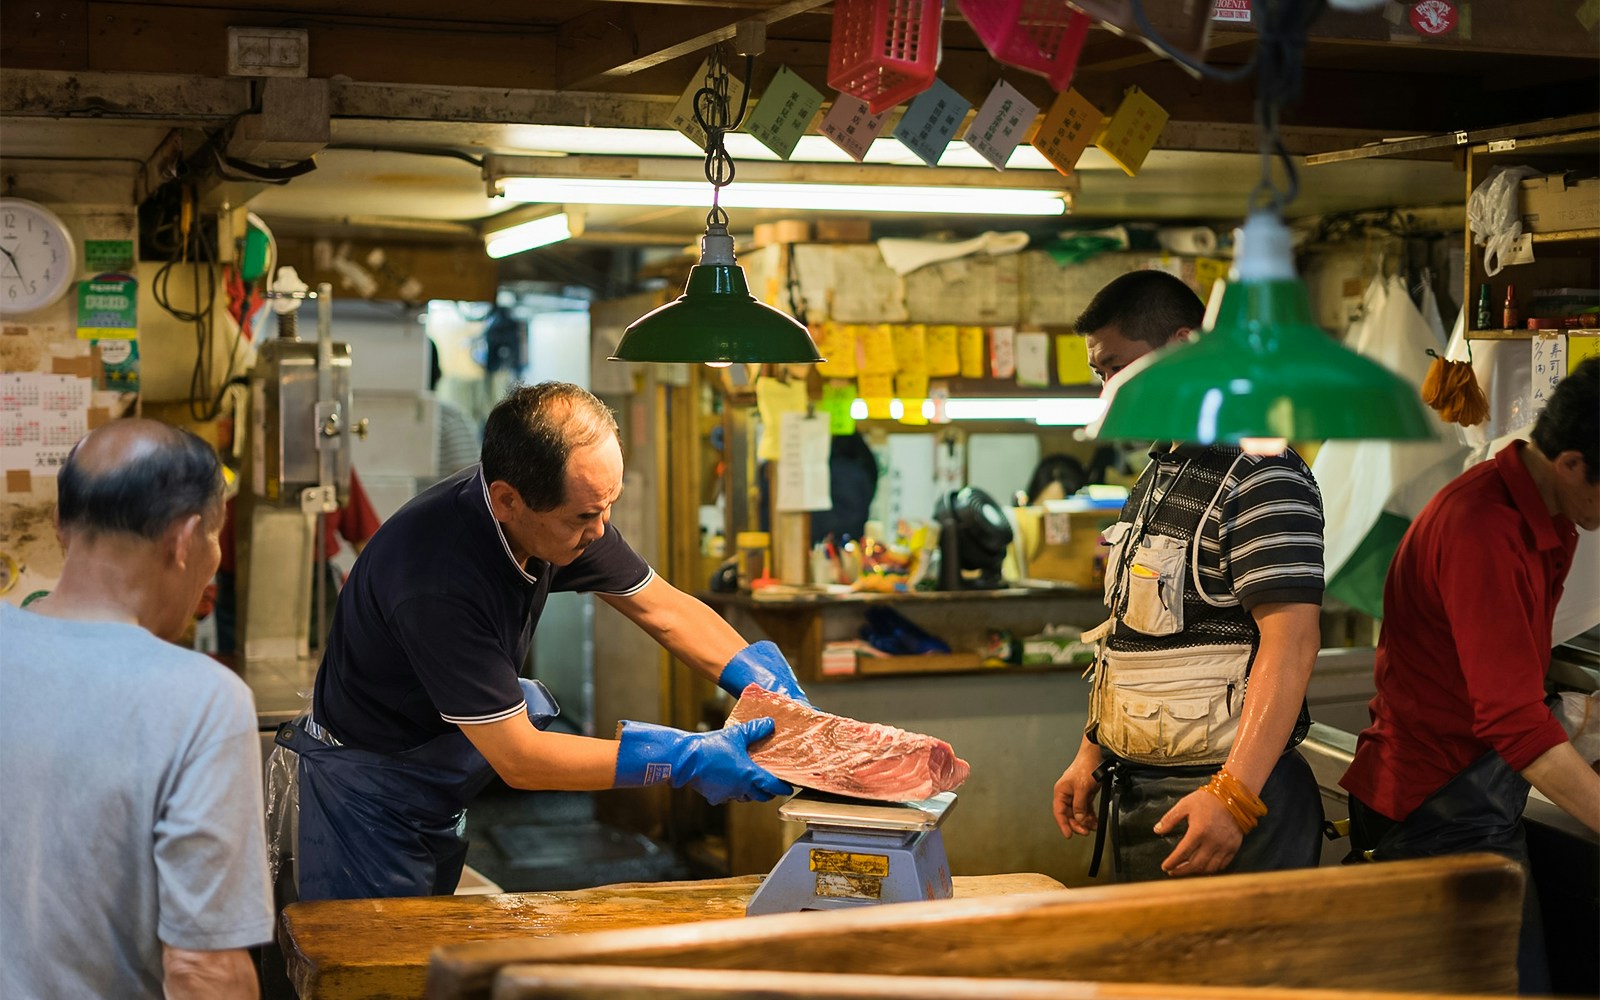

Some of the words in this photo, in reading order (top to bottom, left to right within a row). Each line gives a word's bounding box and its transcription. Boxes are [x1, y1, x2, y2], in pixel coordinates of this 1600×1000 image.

[1214, 0, 1247, 9] HOENIX
[5, 214, 15, 228] 12
[42, 230, 49, 245] 2
[51, 249, 57, 263] 3
[43, 268, 50, 281] 4
[8, 285, 17, 298] 6
[29, 280, 36, 295] 5
